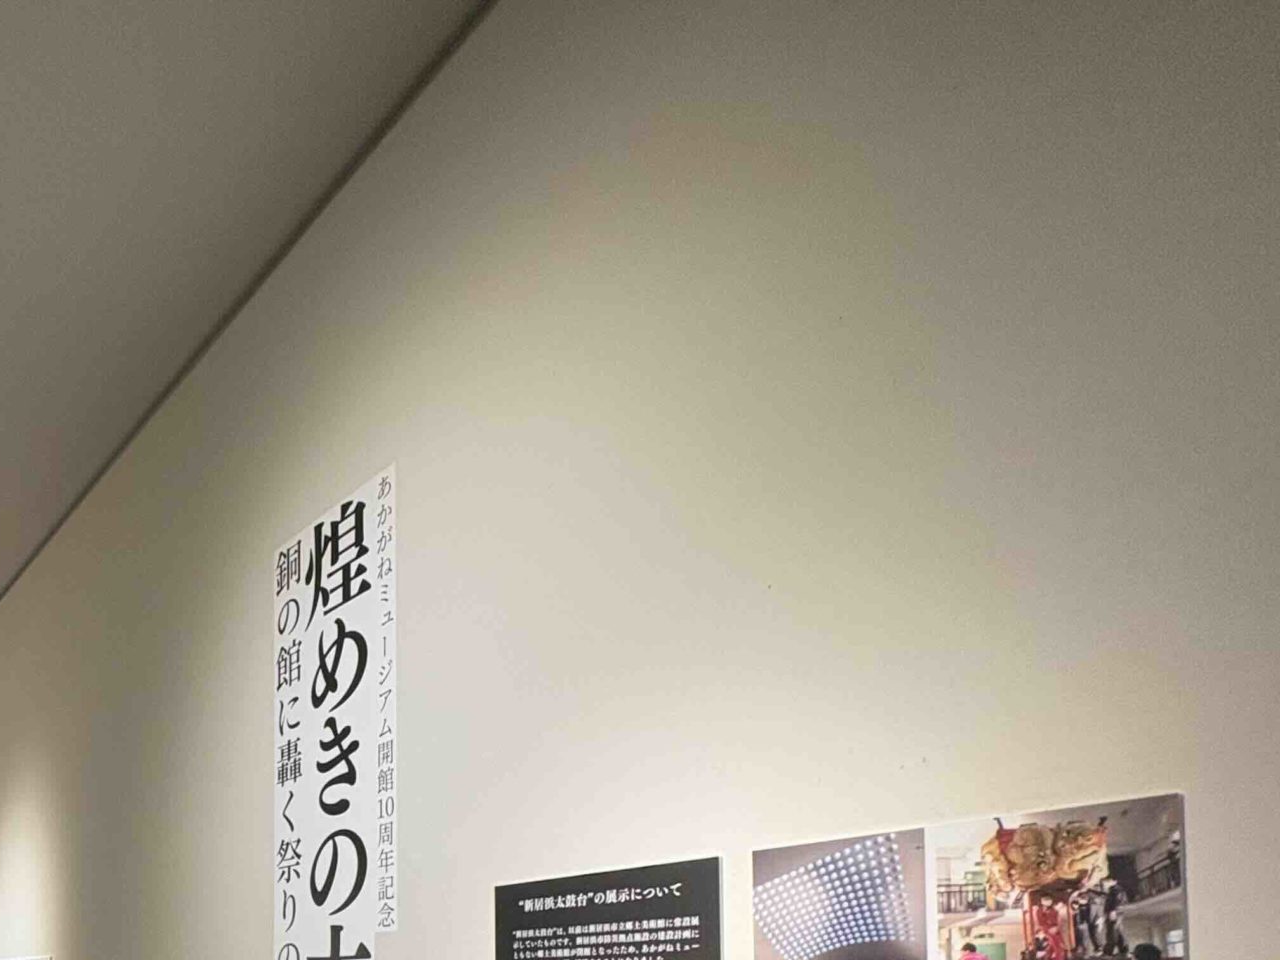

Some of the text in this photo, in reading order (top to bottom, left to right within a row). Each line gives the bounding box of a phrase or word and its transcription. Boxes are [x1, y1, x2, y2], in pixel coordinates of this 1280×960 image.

[376, 476, 396, 928] あかがねミュージアム開館10周年記念
[517, 882, 684, 914] “新居浜太鼓台”の展示について
